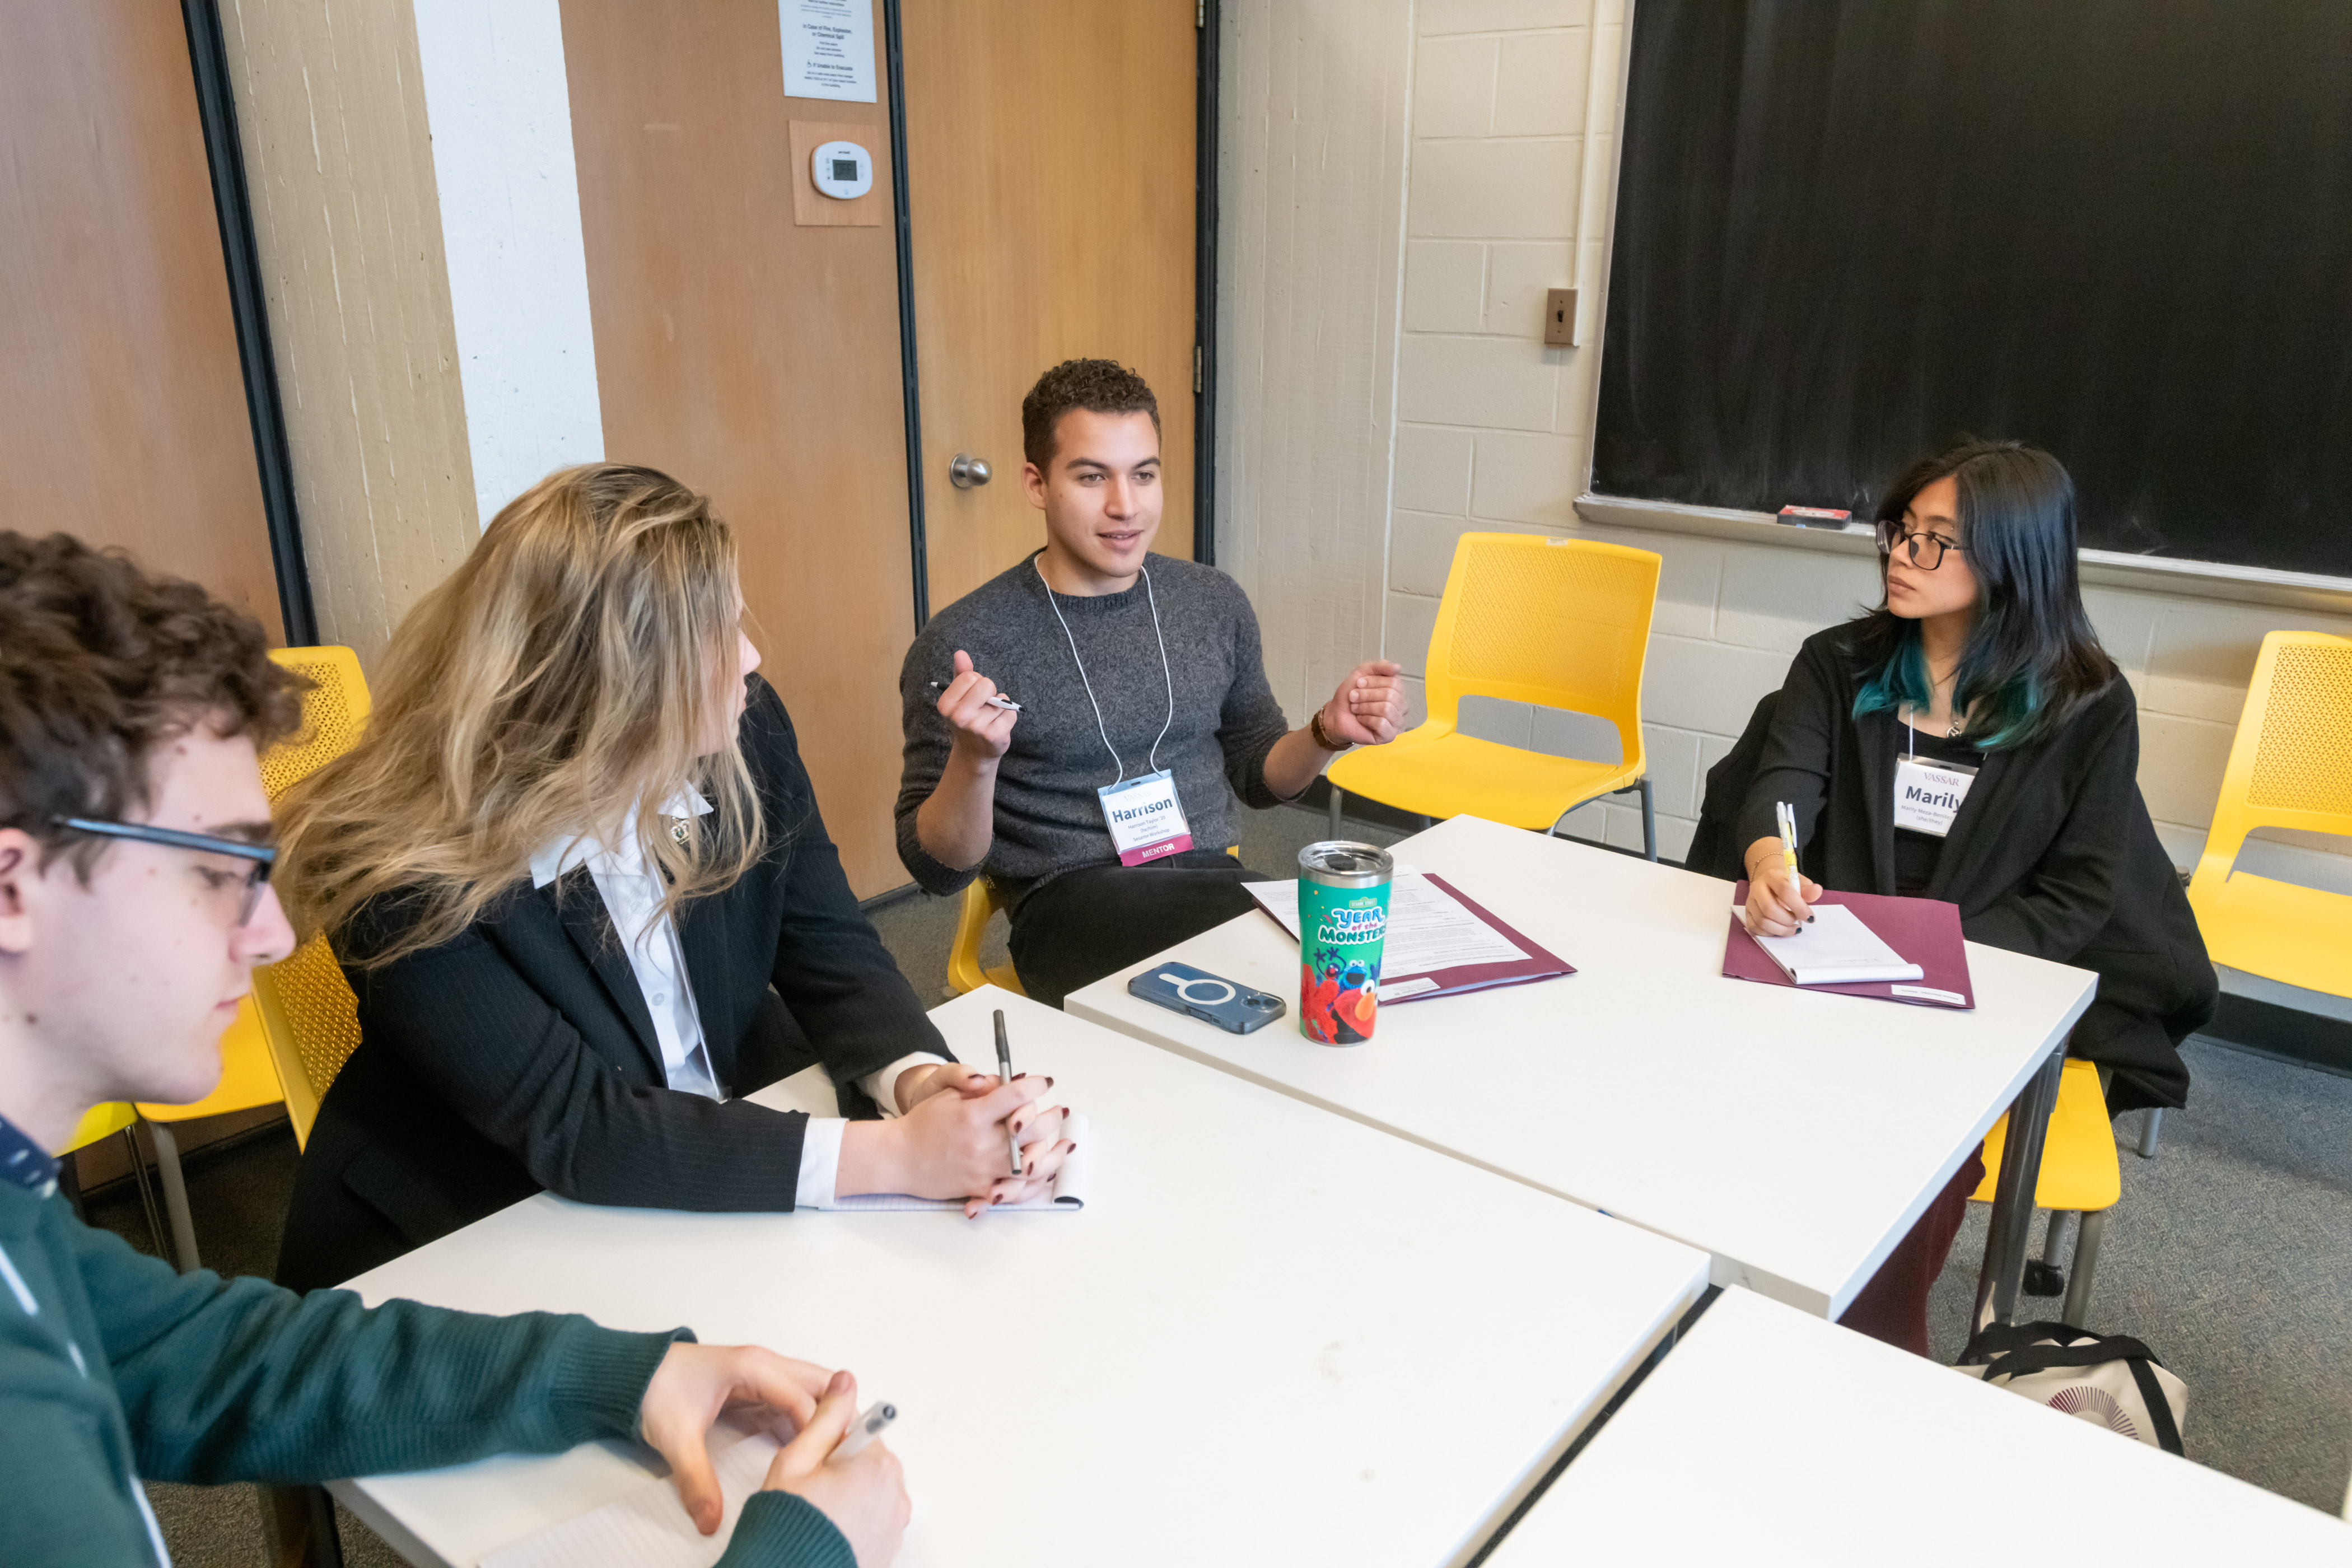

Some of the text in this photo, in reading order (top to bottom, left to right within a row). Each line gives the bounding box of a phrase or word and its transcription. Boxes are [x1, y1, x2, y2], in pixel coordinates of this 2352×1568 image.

[1924, 772, 1959, 786] VASSAR
[1112, 799, 1173, 823] Harrison
[1916, 815, 1943, 826] (she/they)
[1140, 824, 1158, 833] (he/him)
[1149, 828, 1170, 837] Workshop
[1142, 843, 1175, 858] MENTOR
[1333, 908, 1384, 928] YEAR
